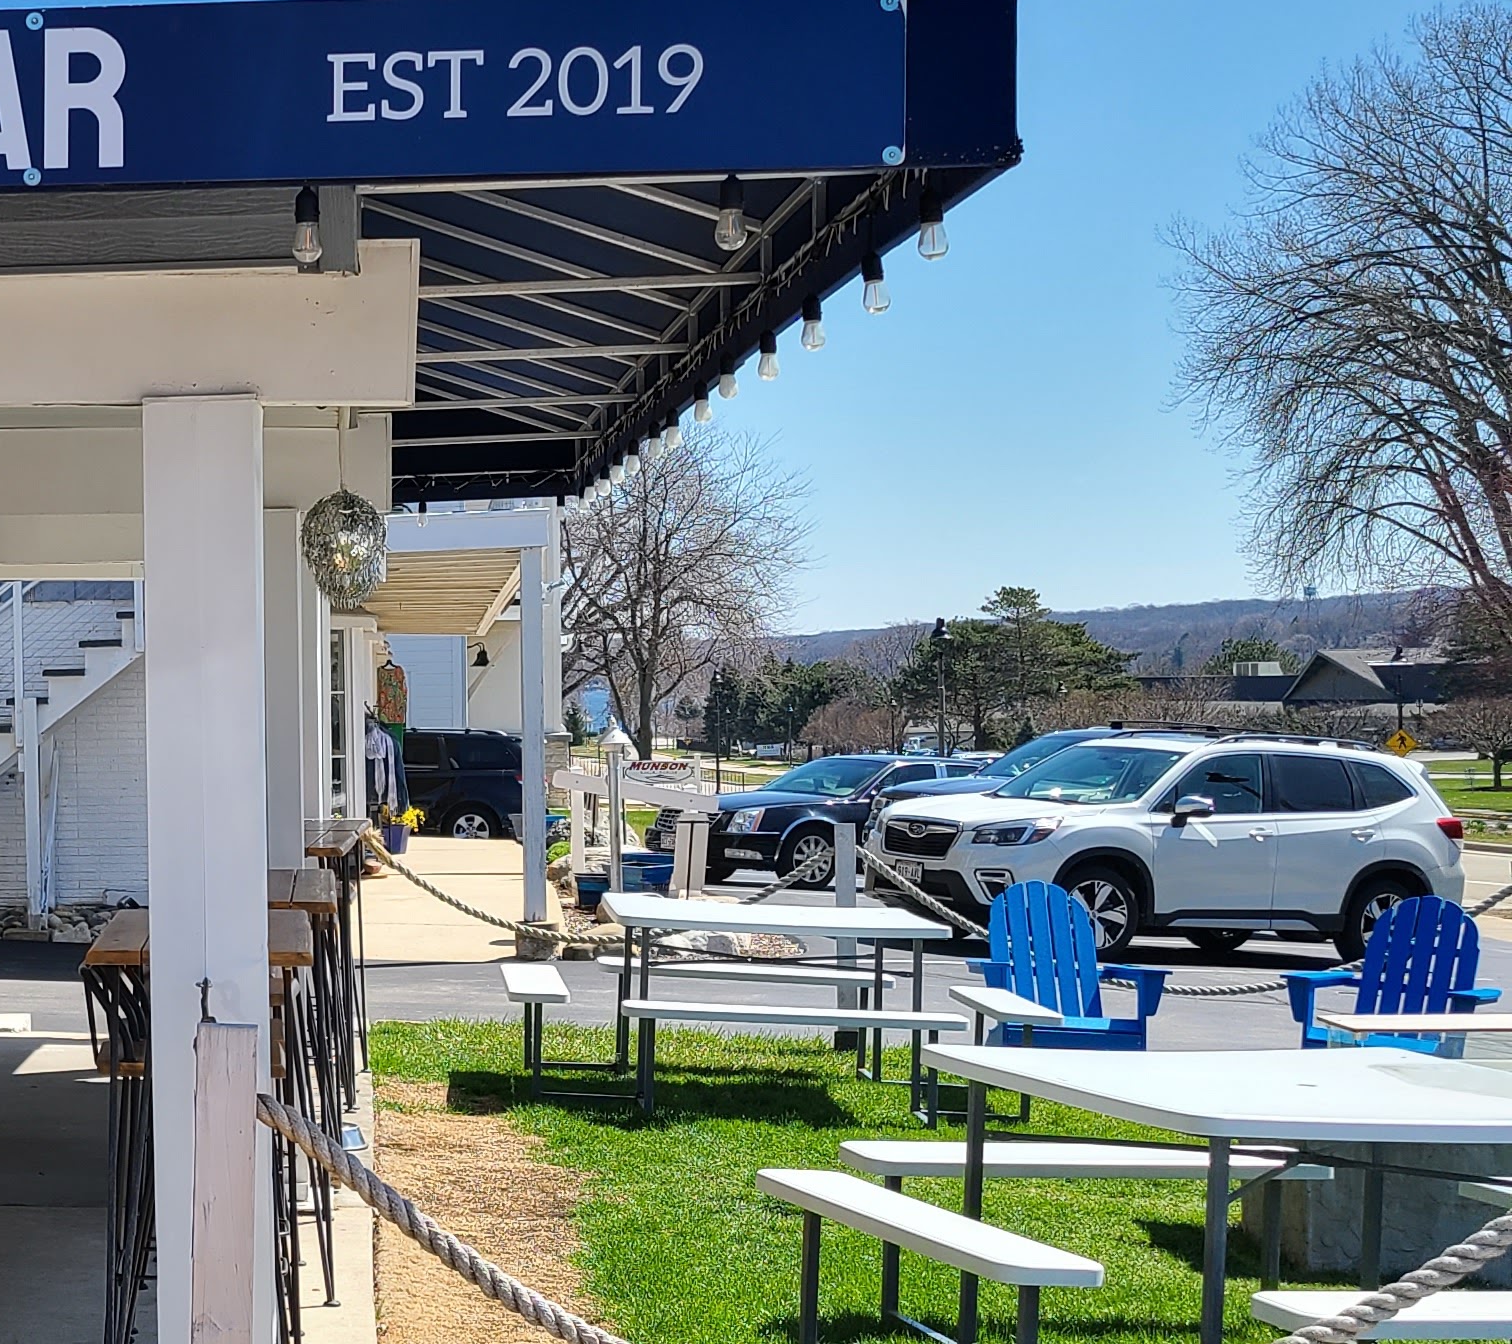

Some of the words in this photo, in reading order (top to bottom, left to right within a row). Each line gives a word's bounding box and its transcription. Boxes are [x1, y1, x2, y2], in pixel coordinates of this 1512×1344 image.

[325, 49, 484, 122] EST
[506, 44, 705, 117] 2019
[629, 761, 689, 771] MUNSON
